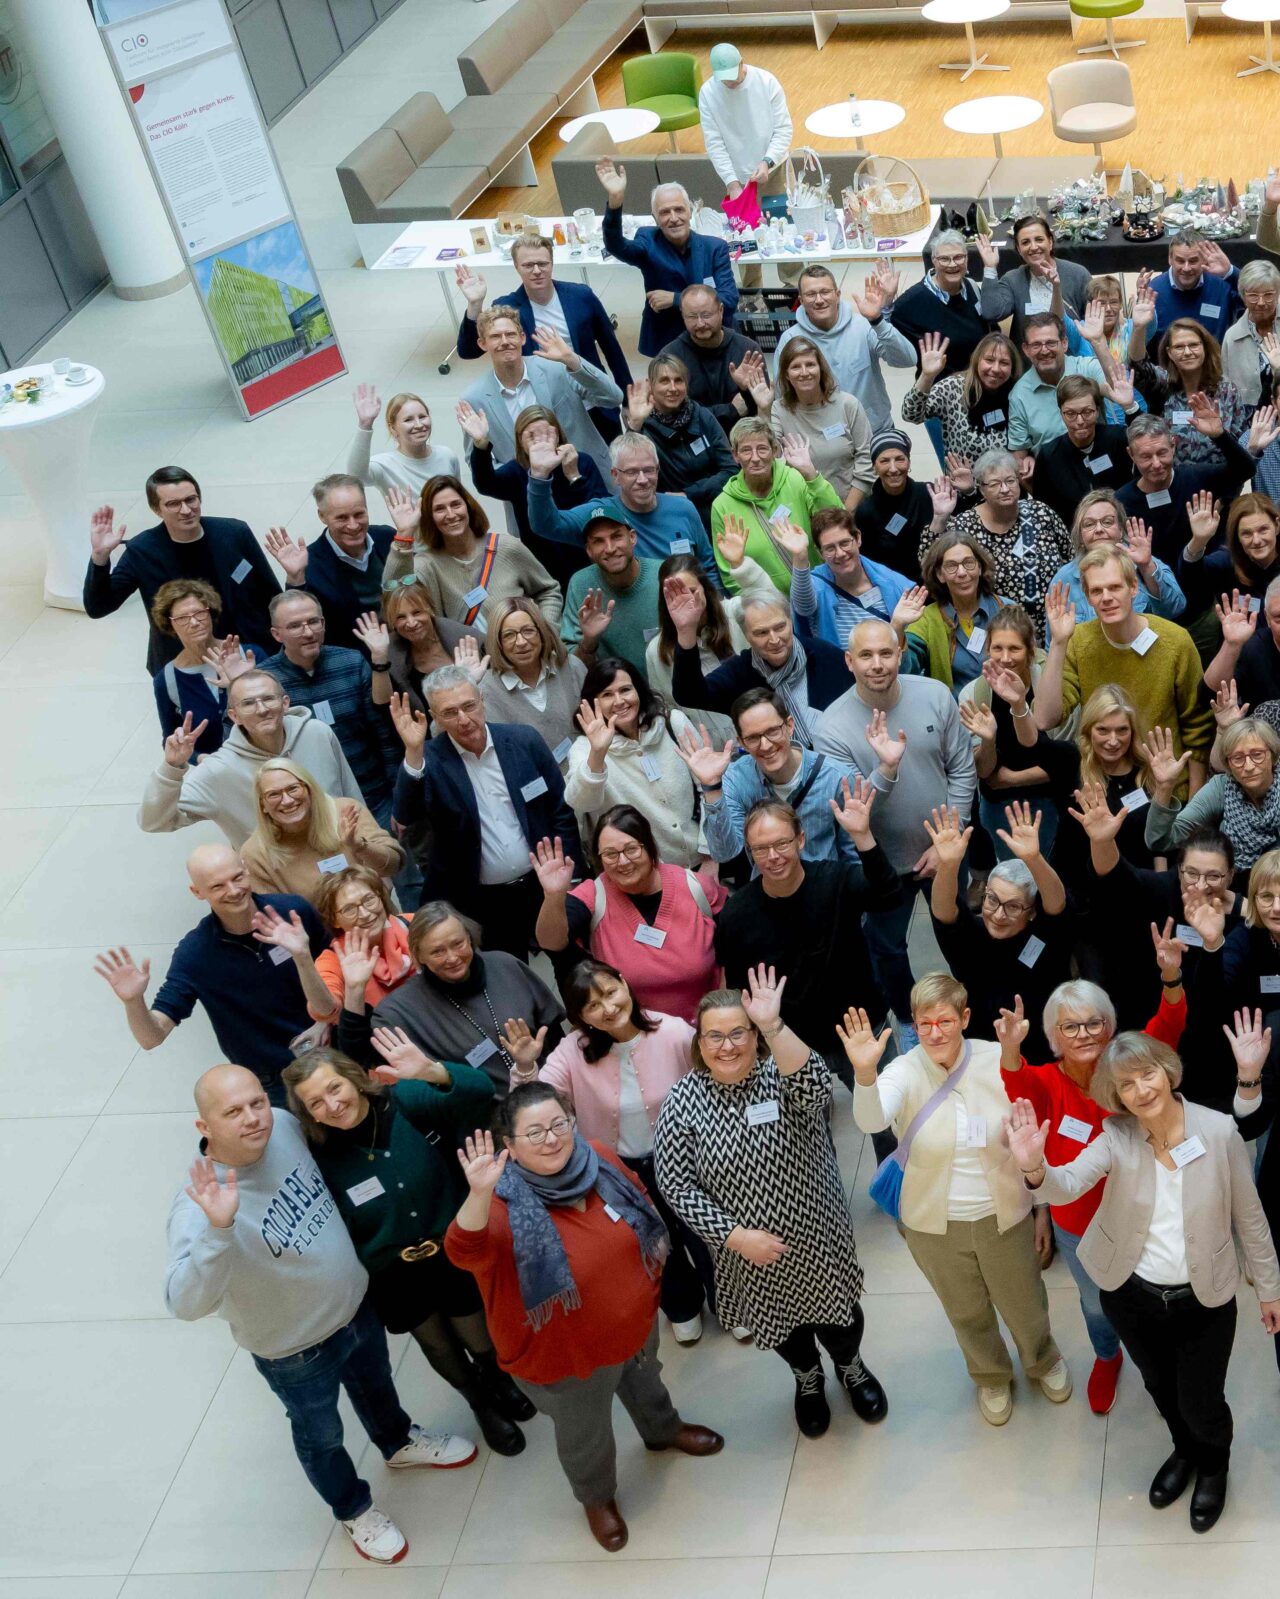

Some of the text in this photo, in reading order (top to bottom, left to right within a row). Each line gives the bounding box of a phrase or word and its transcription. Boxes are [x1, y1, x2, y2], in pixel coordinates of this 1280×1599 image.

[121, 33, 148, 52] CIO
[146, 114, 182, 132] Gemeinsam
[182, 107, 198, 118] stark
[198, 101, 217, 114] gegen
[149, 122, 189, 141] Das CIO Köln
